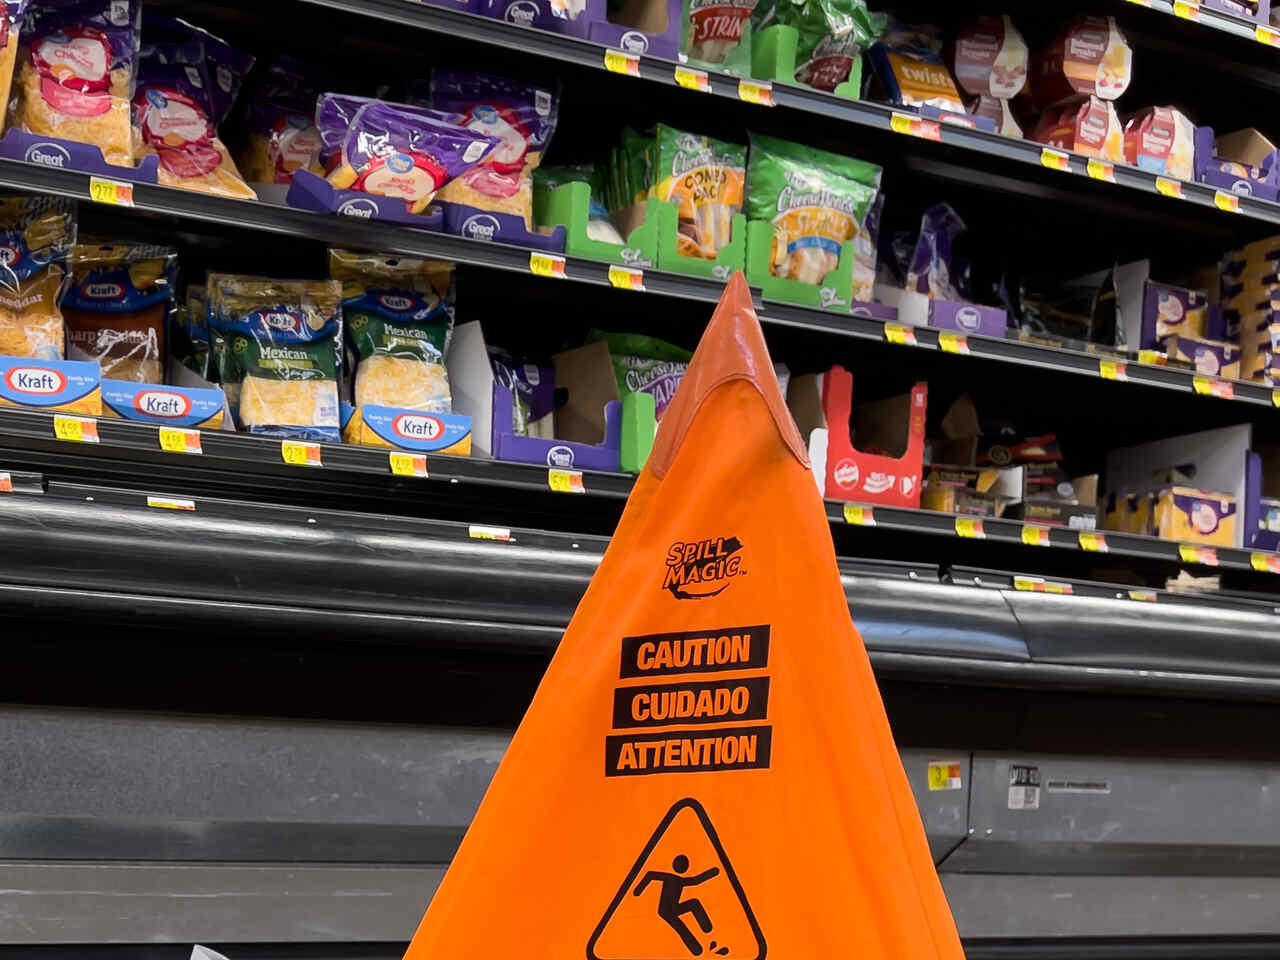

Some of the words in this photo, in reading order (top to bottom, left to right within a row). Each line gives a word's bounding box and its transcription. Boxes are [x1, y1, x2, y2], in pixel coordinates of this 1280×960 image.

[699, 15, 745, 39] STRIN
[30, 150, 65, 168] Great
[90, 284, 117, 297] Kraft
[384, 323, 428, 340] Mexican
[260, 345, 308, 360] Mexican
[18, 373, 54, 390] Kraft
[146, 396, 180, 414] Kraft
[403, 420, 433, 436] Kraft
[665, 536, 728, 567] SPILL
[662, 556, 741, 590] MAGIC
[636, 634, 751, 671] CAUTION
[631, 686, 750, 722] CUIDADO
[616, 734, 758, 770] ATTENTION
